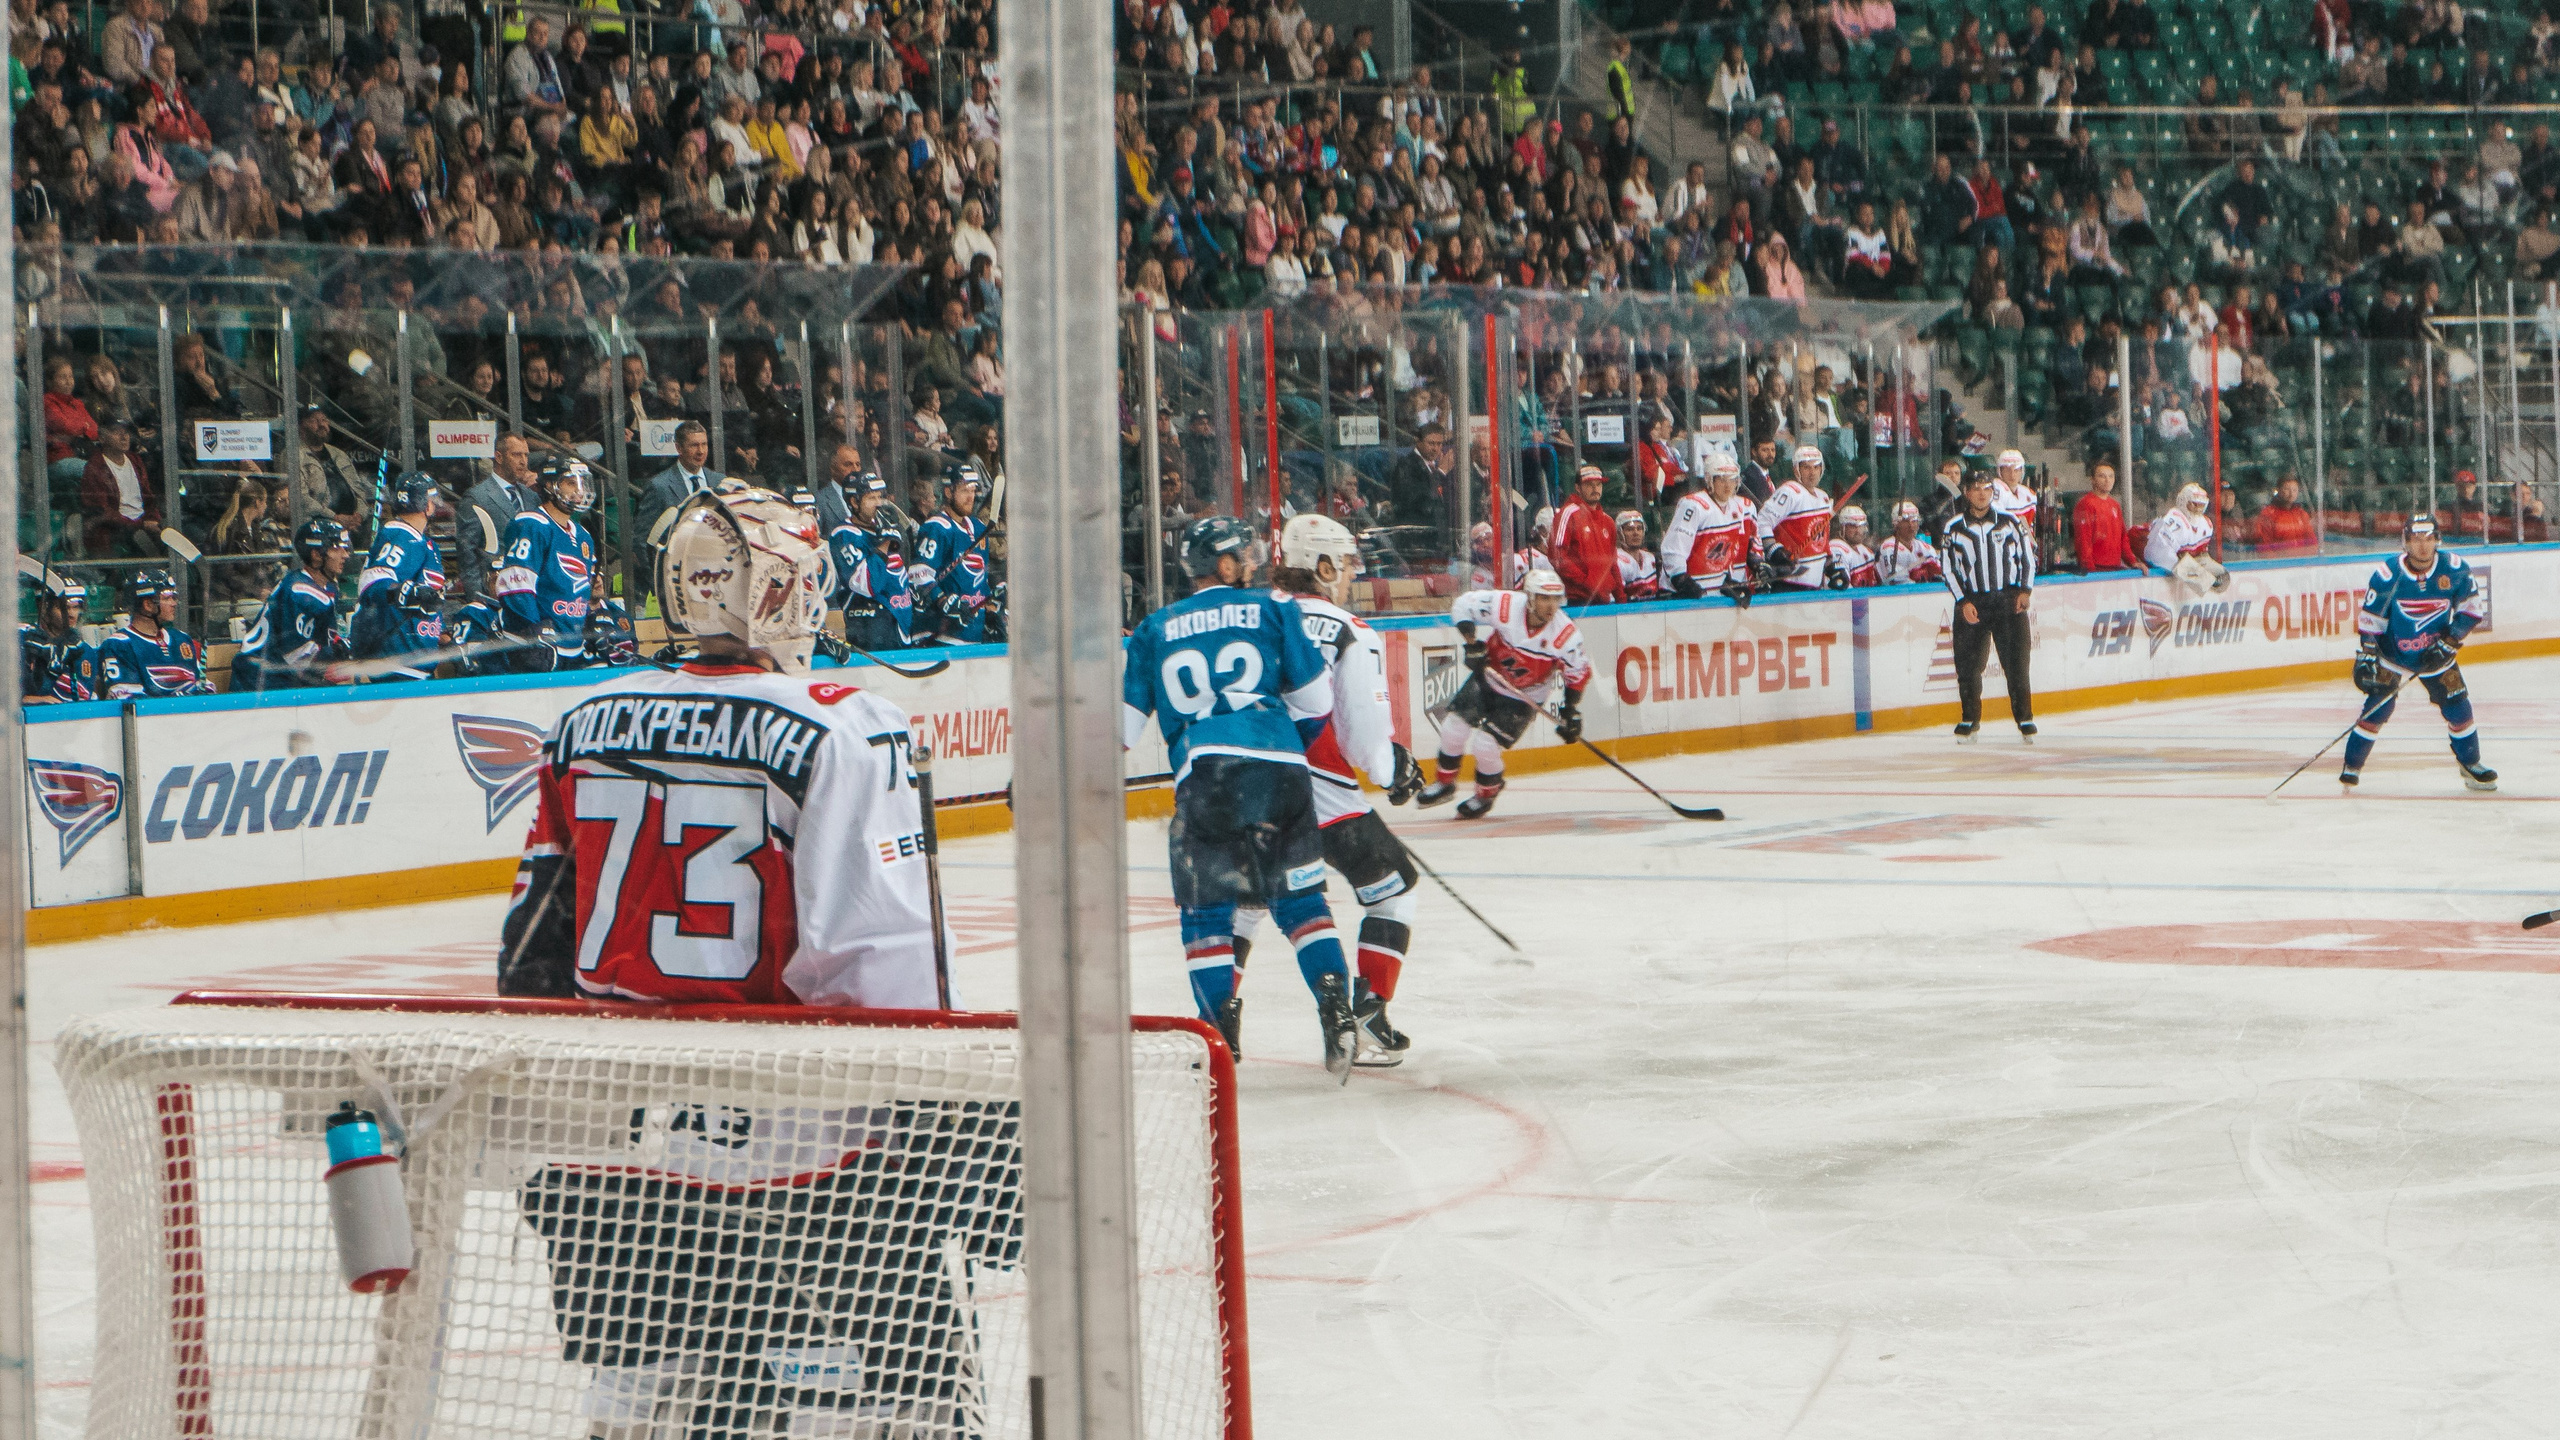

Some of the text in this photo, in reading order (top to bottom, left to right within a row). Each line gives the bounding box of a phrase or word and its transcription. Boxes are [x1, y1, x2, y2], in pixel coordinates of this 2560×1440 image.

[436, 433, 490, 445] OLIMPBET
[1683, 508, 1694, 522] 9
[376, 542, 405, 567] 95
[507, 538, 531, 560] 28
[918, 537, 938, 560] 43
[848, 609, 876, 617] CCM
[1164, 604, 1261, 642] ЯКОВЛЕВ
[2174, 600, 2251, 648] СОКОЛ!
[296, 613, 315, 639] 66
[453, 620, 471, 645] 27
[1616, 631, 1837, 705] OLIMPBET
[557, 698, 818, 778] ПОДСКРЕБАЛИН
[145, 749, 389, 843] СОКОЛ!
[575, 774, 768, 981] 73
